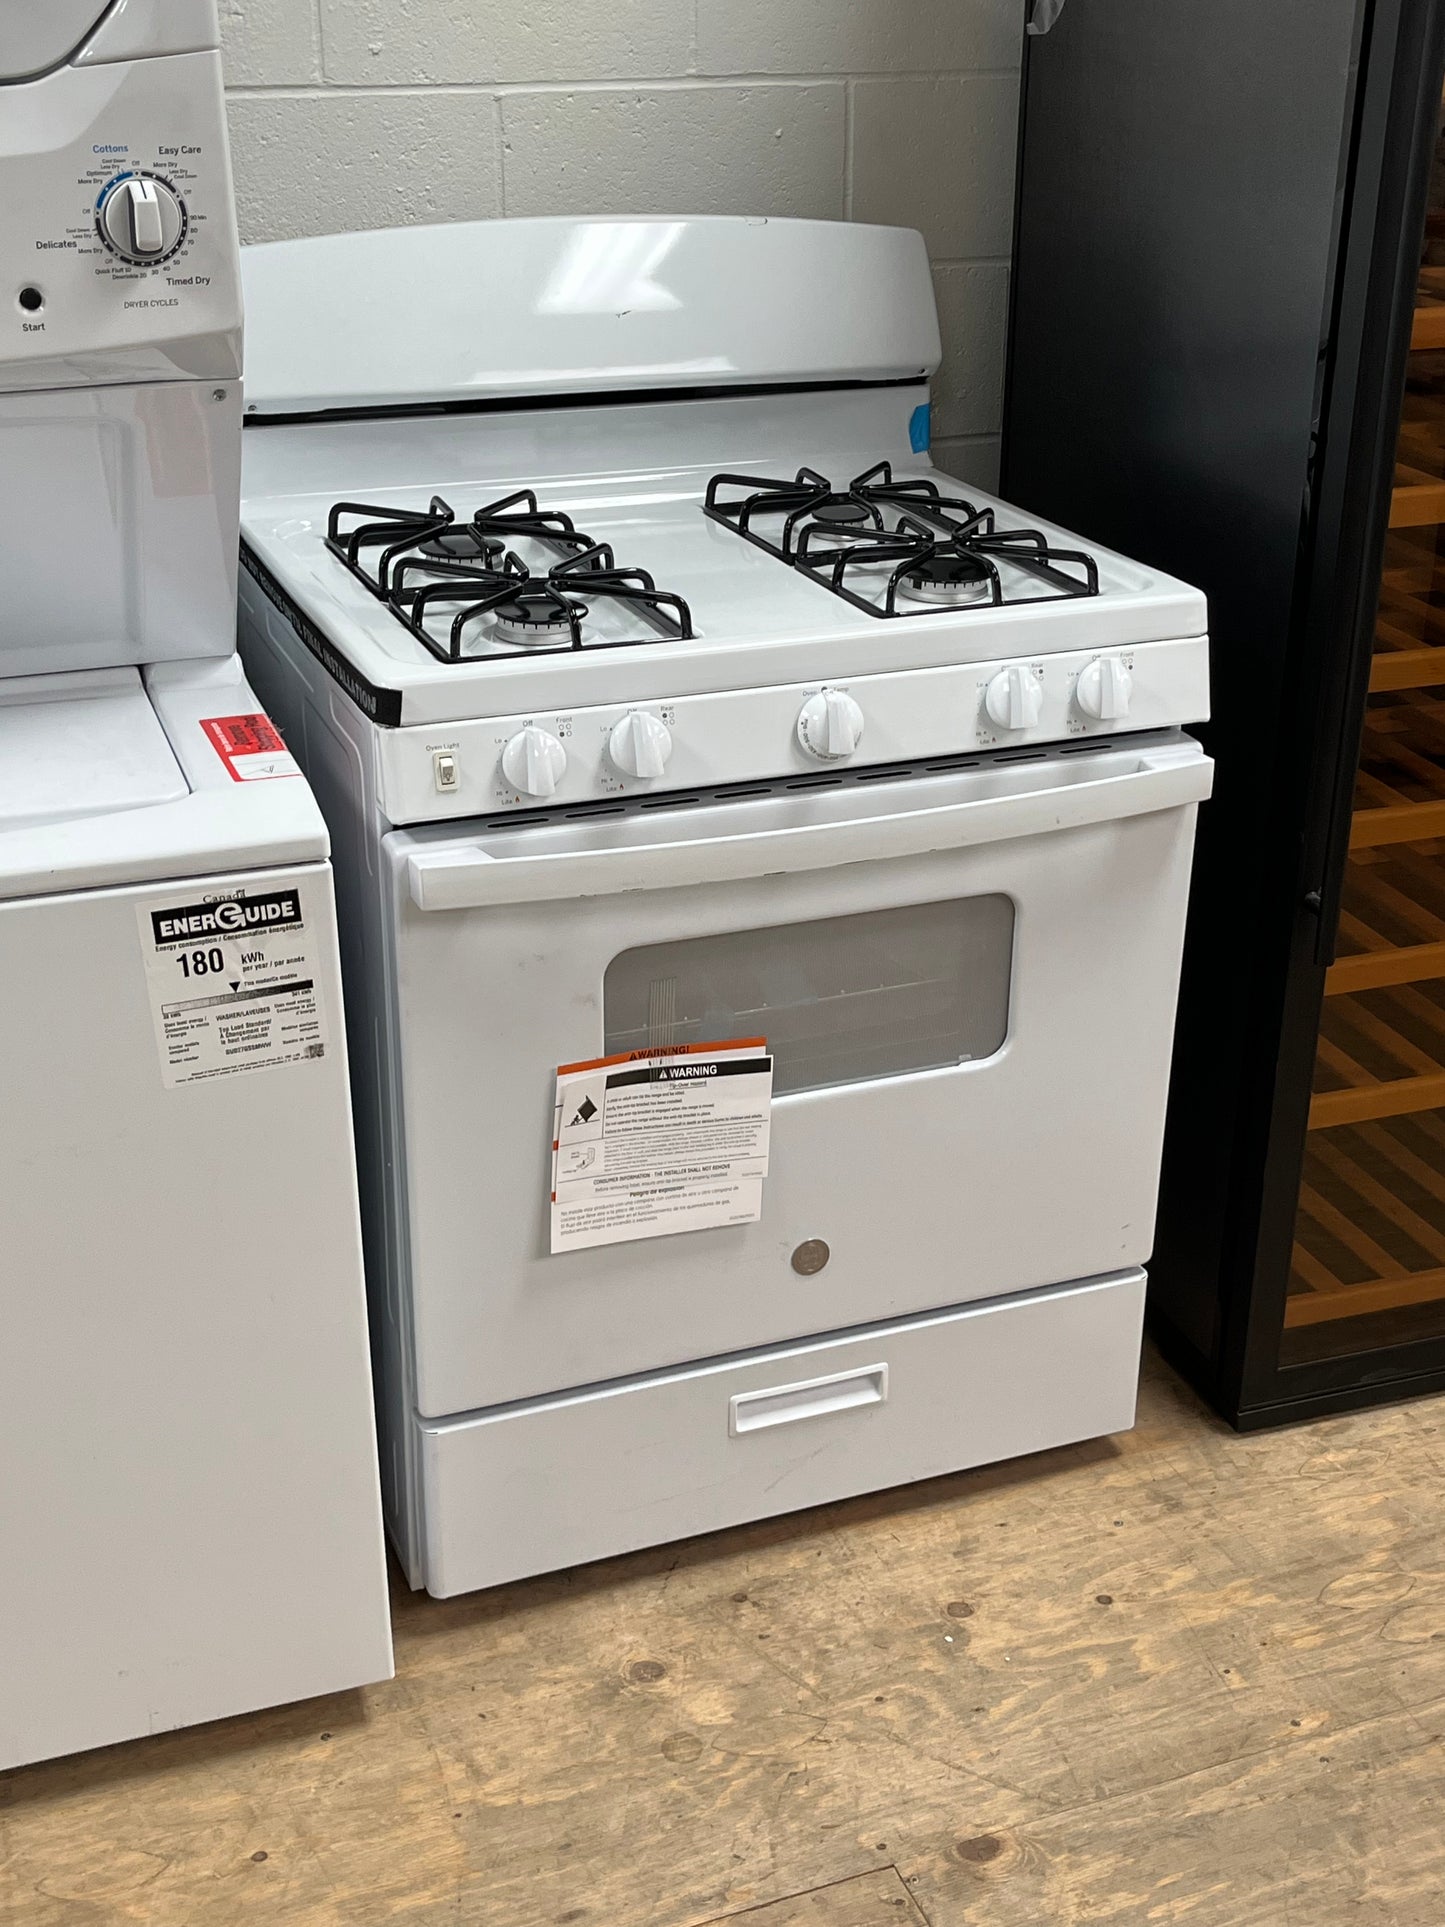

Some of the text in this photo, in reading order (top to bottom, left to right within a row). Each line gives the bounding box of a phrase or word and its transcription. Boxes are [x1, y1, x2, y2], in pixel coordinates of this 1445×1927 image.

[93, 145, 129, 153] Cottons
[158, 146, 201, 156] Easy Care
[36, 240, 77, 249] Delicates
[166, 276, 210, 286] Timed Dry
[124, 299, 178, 309] DRYER CYCLES
[22, 323, 45, 332] Start
[322, 648, 377, 714] INSTALLATION
[443, 742, 460, 750] Light
[202, 889, 246, 903] Canada
[159, 900, 295, 938] ENERGUIDE
[155, 944, 177, 952] Energy
[178, 936, 218, 949] consumption
[223, 928, 267, 942] Consommation
[268, 923, 304, 934] énergétique
[176, 948, 225, 978] 180
[241, 951, 264, 964] kWh
[242, 965, 254, 973] per
[254, 962, 268, 971] year
[274, 960, 286, 968] par
[286, 956, 305, 964] année
[216, 1006, 270, 1021] WASHER/LAVEUSES
[231, 1023, 244, 1031] Load
[246, 1018, 272, 1028] Standard/
[637, 1045, 690, 1059] WARNING!
[669, 1065, 718, 1078] WARNING
[593, 1177, 618, 1185] CONSUMER
[619, 1173, 650, 1181] INFORMATION
[664, 1168, 686, 1176] INSTALLER
